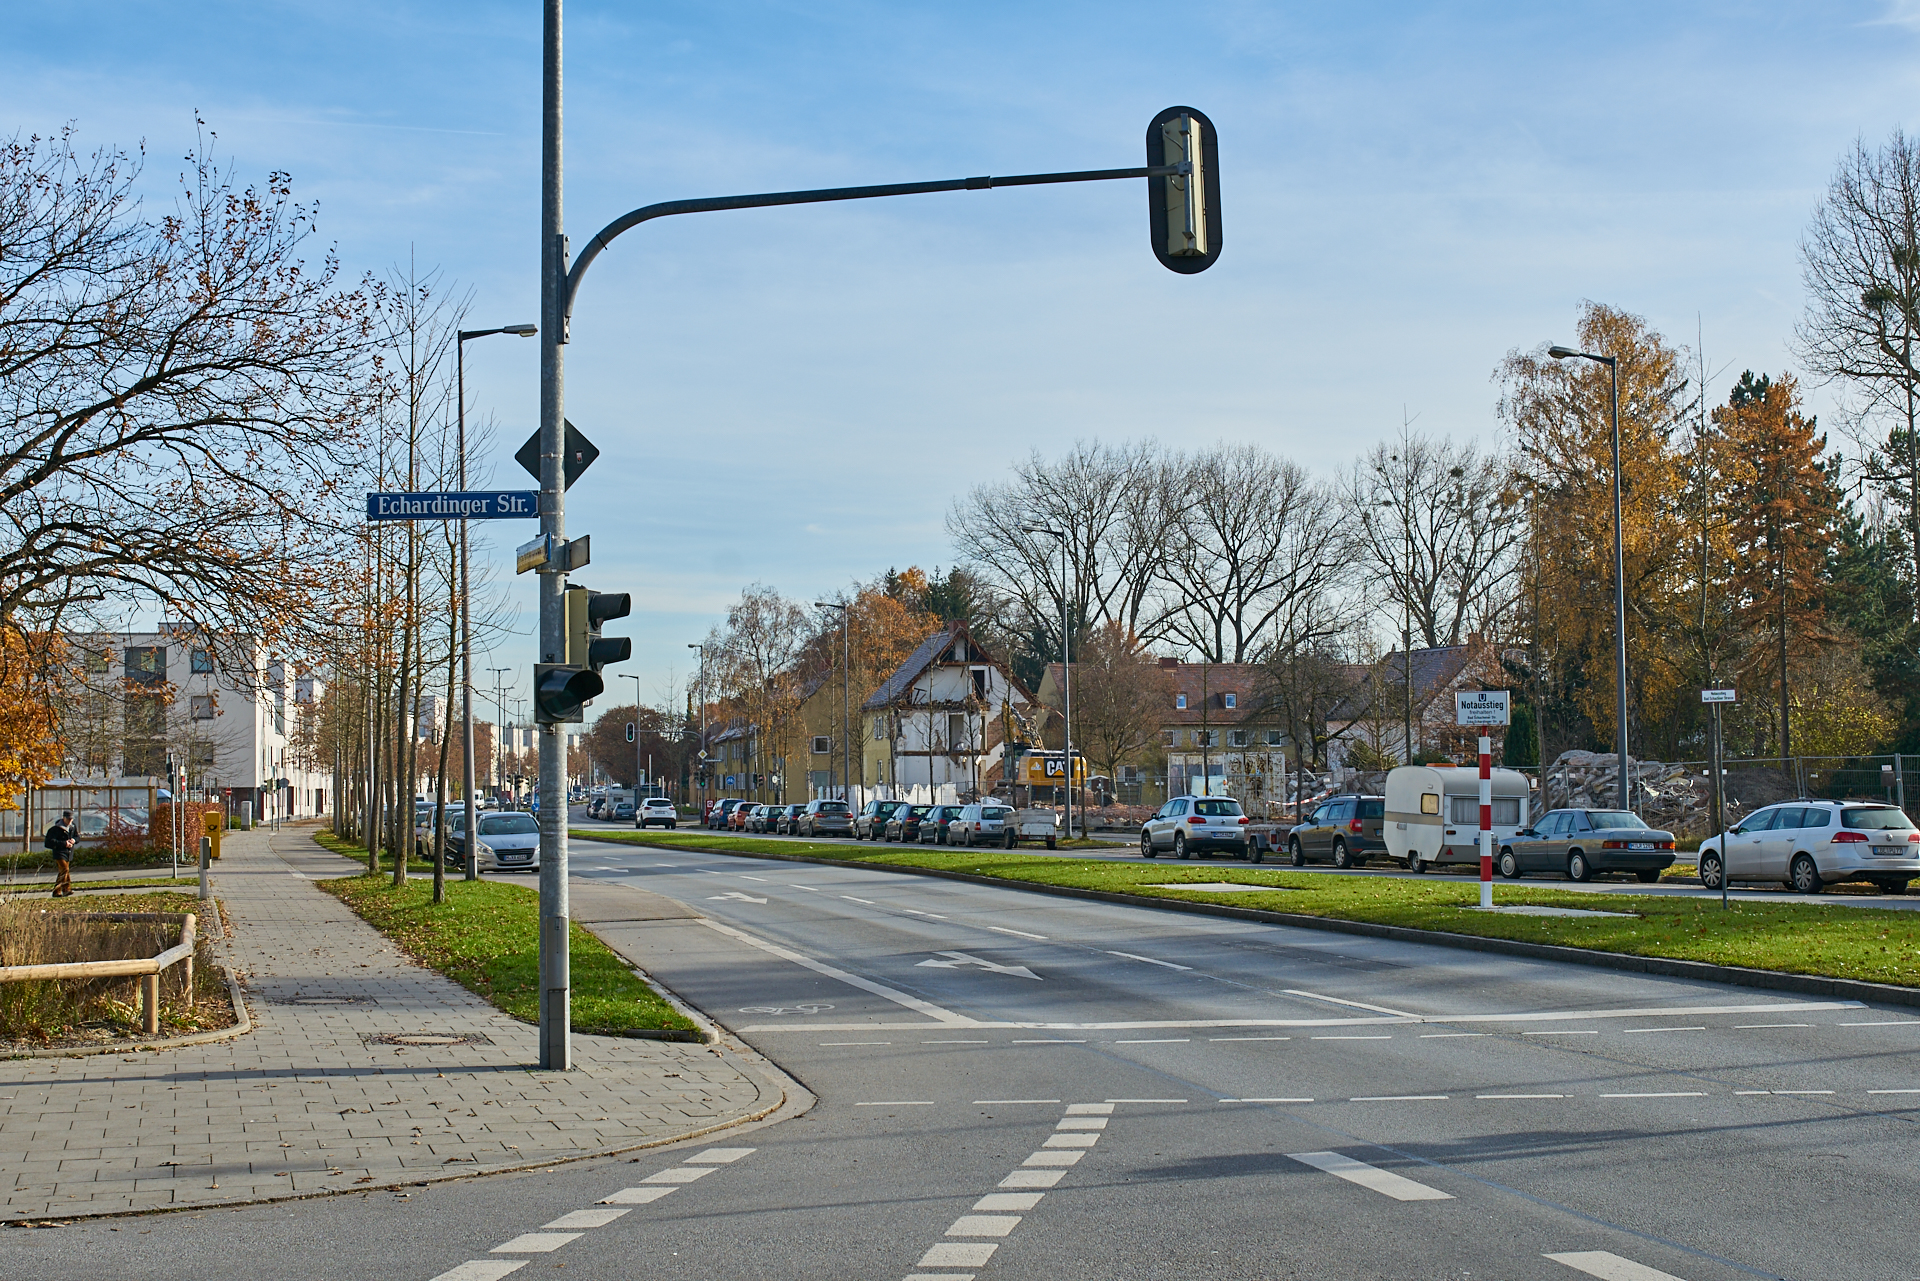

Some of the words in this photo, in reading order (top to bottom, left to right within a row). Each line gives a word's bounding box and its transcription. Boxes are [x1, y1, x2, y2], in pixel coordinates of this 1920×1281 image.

[378, 496, 490, 517] Echardinger
[497, 494, 529, 513] Str.
[1461, 701, 1503, 710] Notausstieg
[1046, 761, 1065, 776] CA
